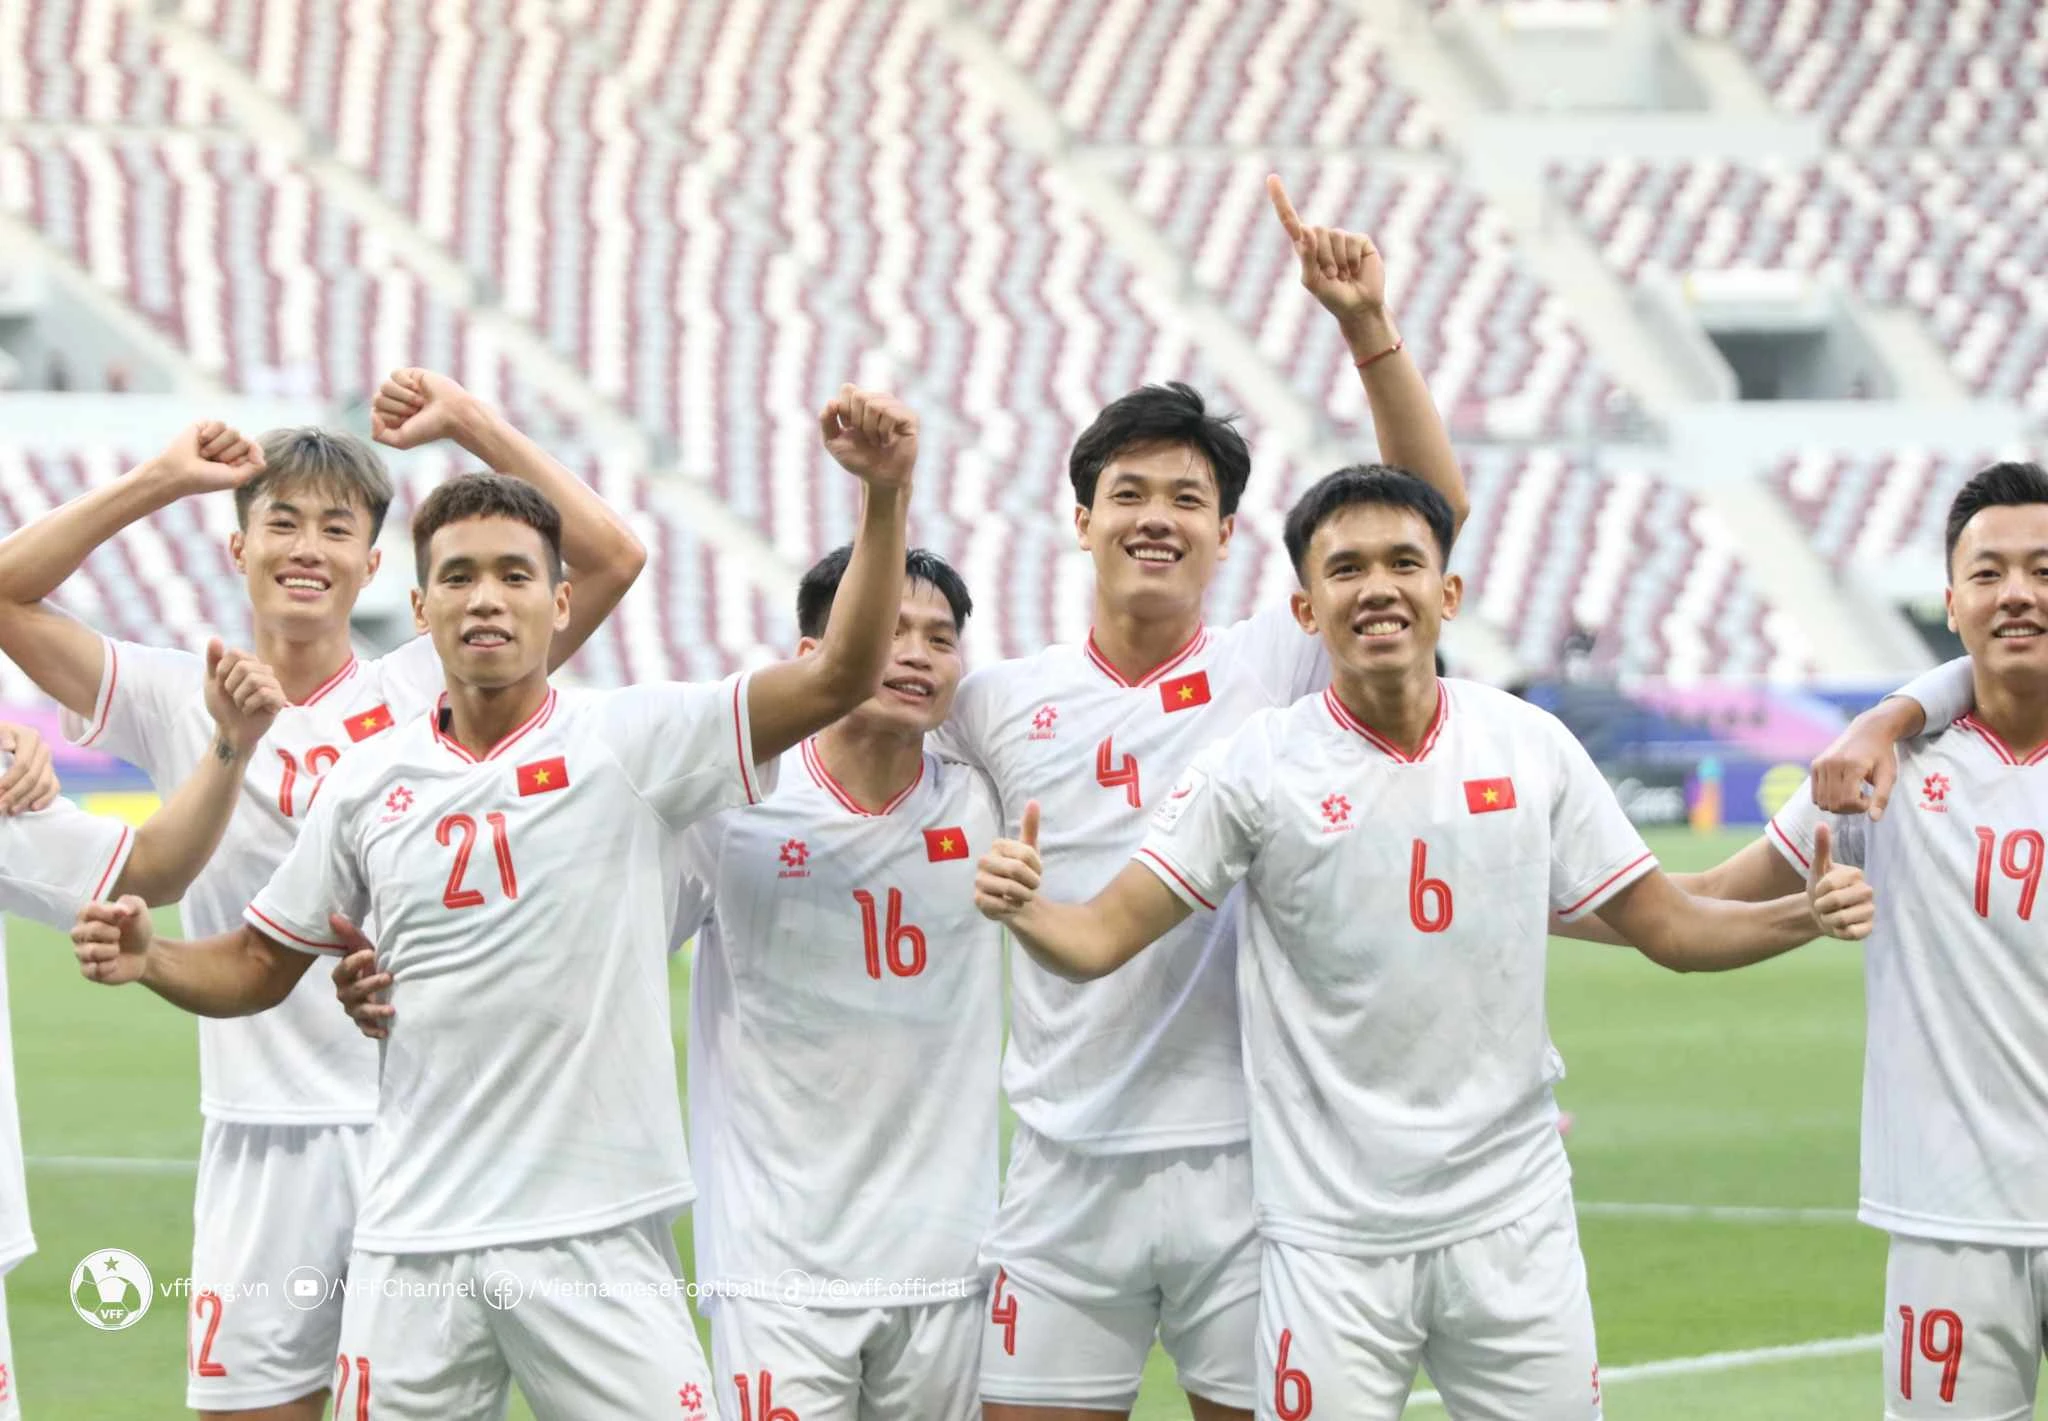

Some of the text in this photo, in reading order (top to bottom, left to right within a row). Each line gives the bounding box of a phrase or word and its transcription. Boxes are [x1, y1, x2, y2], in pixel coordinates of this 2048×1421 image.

[1096, 735, 1141, 808] 4
[435, 811, 518, 909] 21
[1409, 839, 1453, 933] 6
[1975, 826, 2045, 921] 19
[852, 887, 927, 979] 16
[992, 1263, 1017, 1356] 4
[1899, 1305, 1963, 1402] 19
[1274, 1328, 1312, 1421] 6
